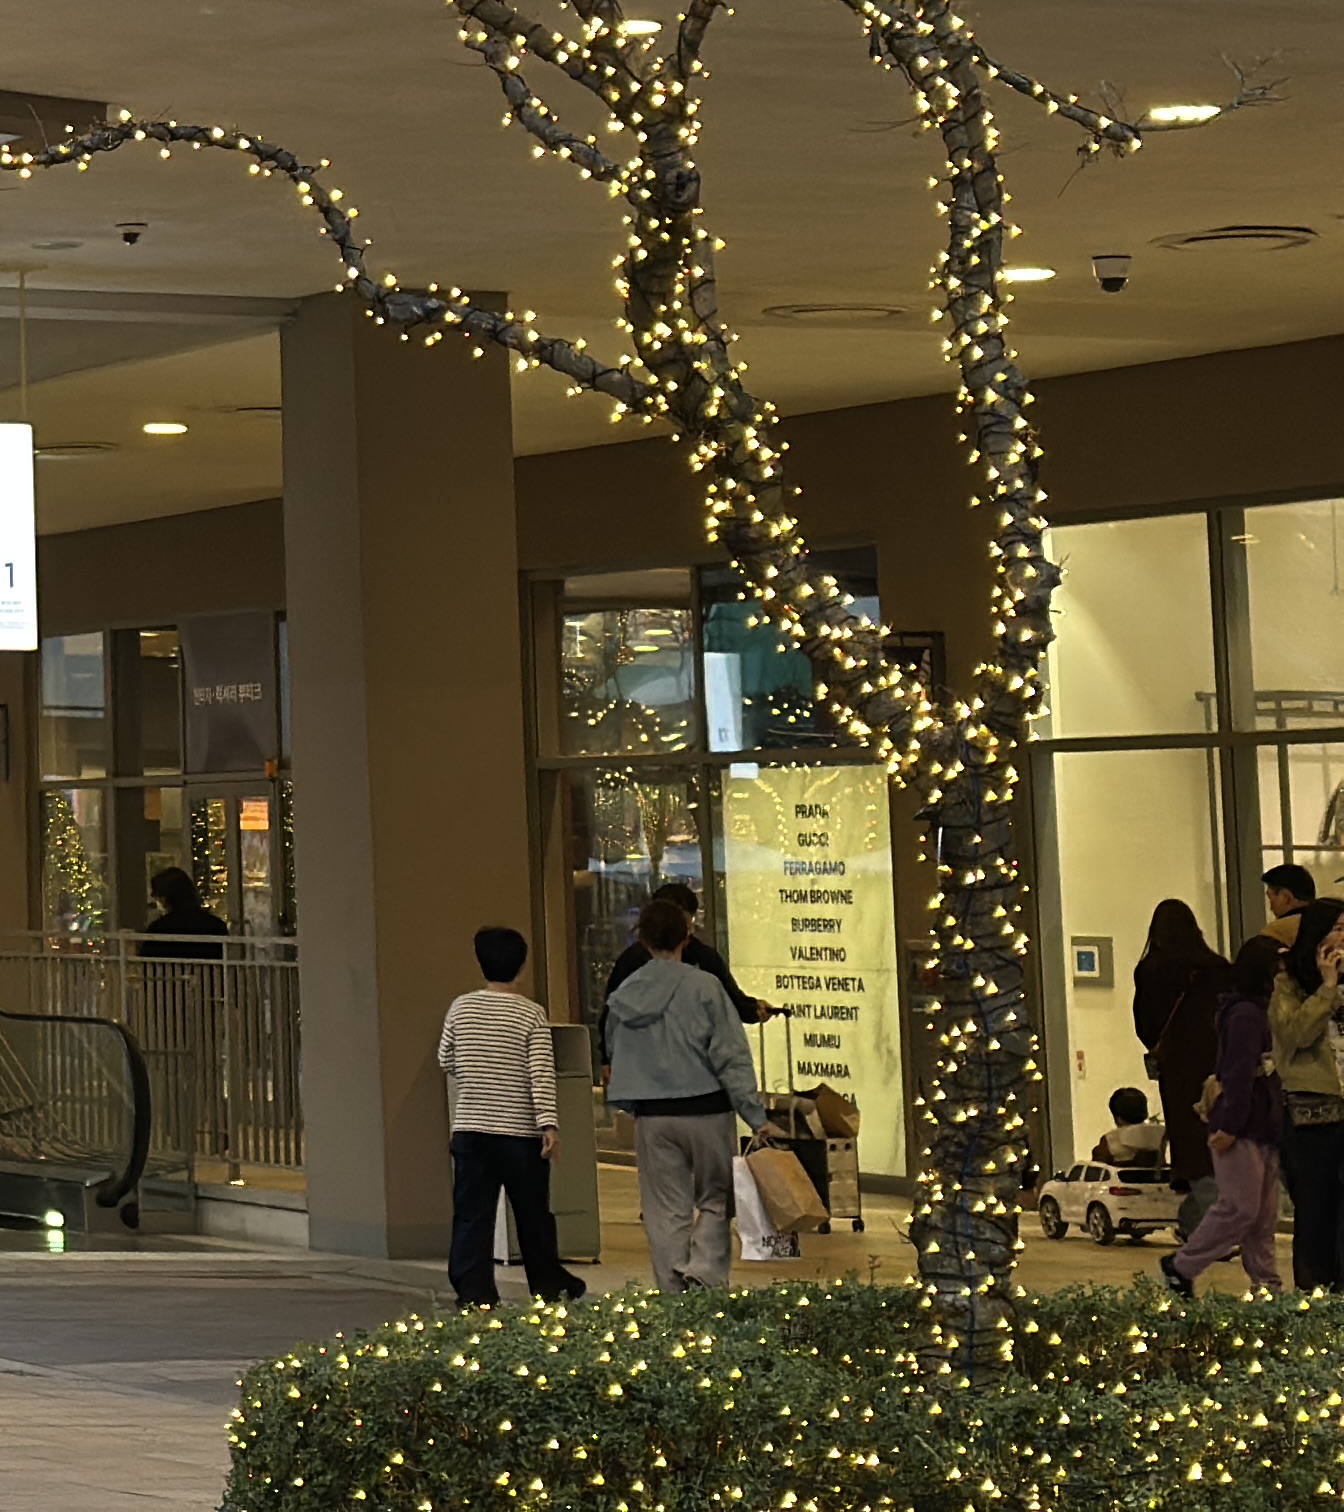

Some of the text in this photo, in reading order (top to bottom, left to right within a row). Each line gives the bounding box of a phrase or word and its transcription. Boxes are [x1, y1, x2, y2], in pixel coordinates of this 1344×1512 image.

[794, 804, 829, 819] PRADA
[797, 832, 829, 848] GUCCI
[783, 860, 846, 876] FERRAGAMO
[779, 889, 853, 905] THOM BROWNE
[791, 917, 842, 934] BURBERRY
[790, 946, 847, 963] VALENTINO
[775, 974, 866, 993] BOTTEGA VENETA
[814, 1004, 860, 1022] LAURENT
[797, 1060, 851, 1079] MAXMARA
